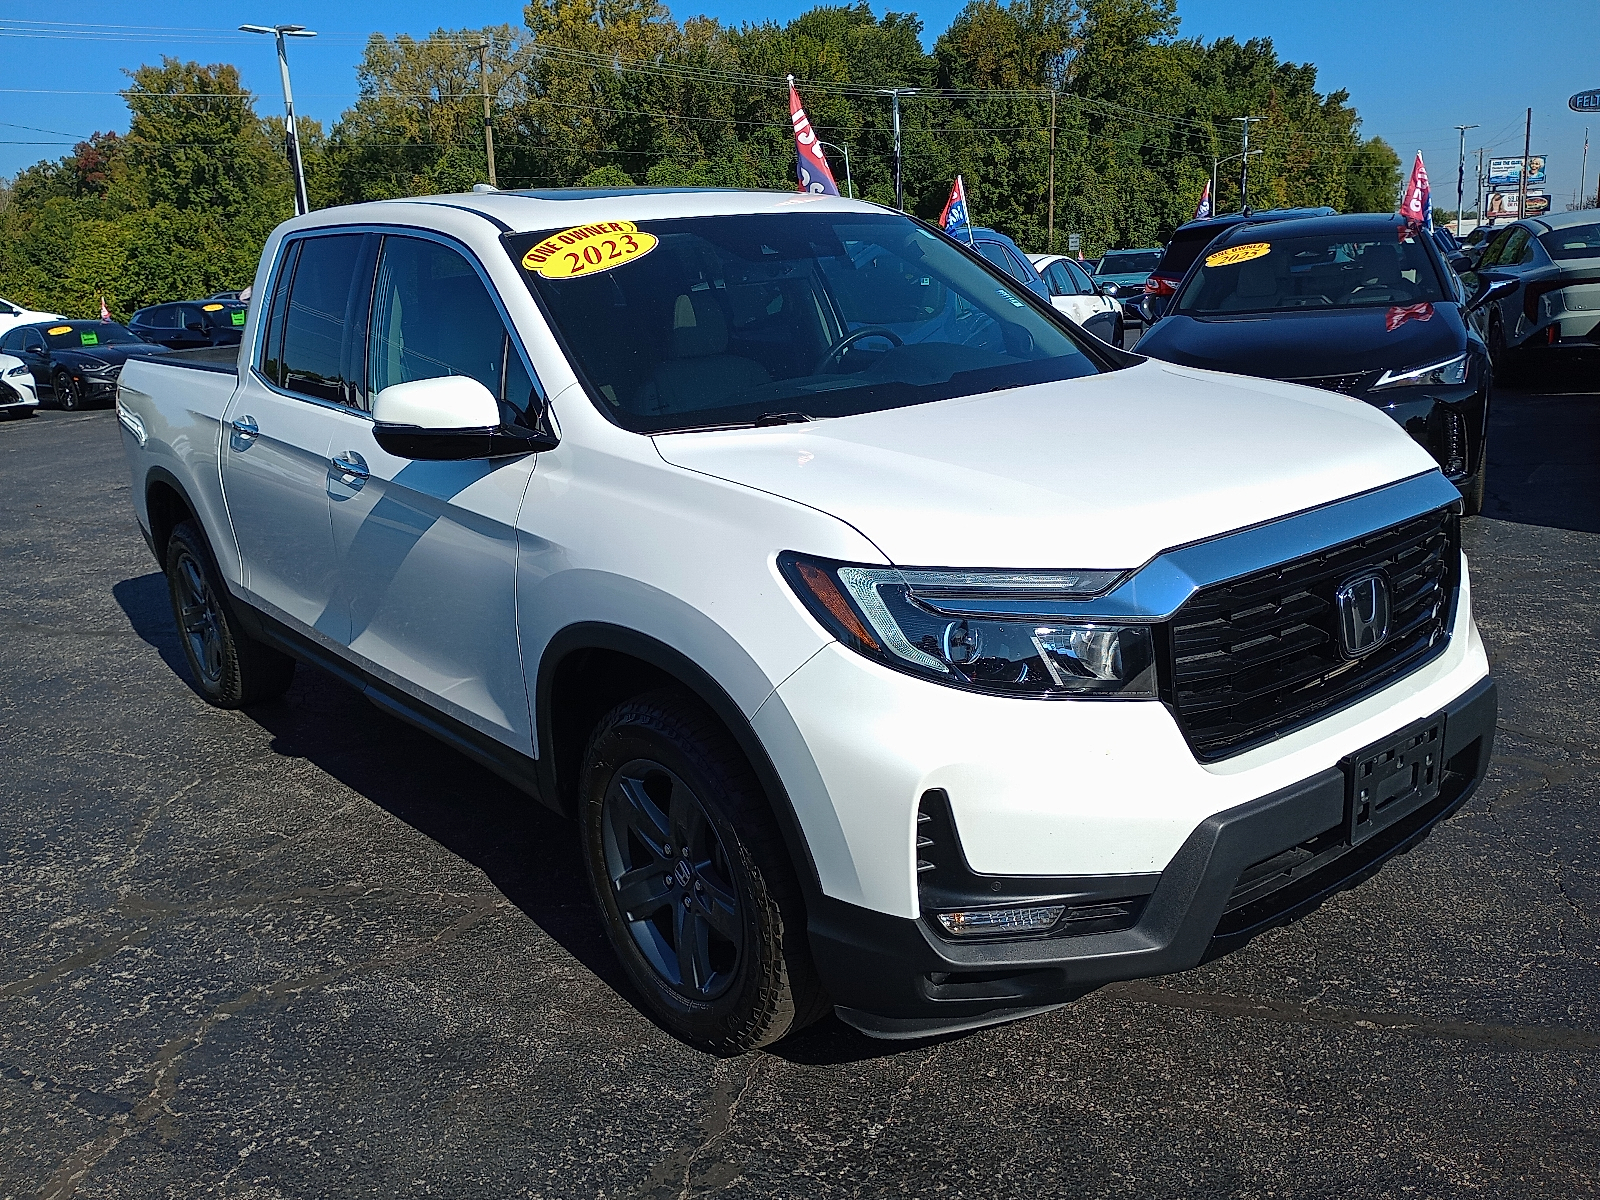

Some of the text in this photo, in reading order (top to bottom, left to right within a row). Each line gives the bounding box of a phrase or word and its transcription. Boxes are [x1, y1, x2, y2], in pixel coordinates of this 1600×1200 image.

[526, 222, 624, 263] ONE OWNER
[563, 234, 639, 273] 2023
